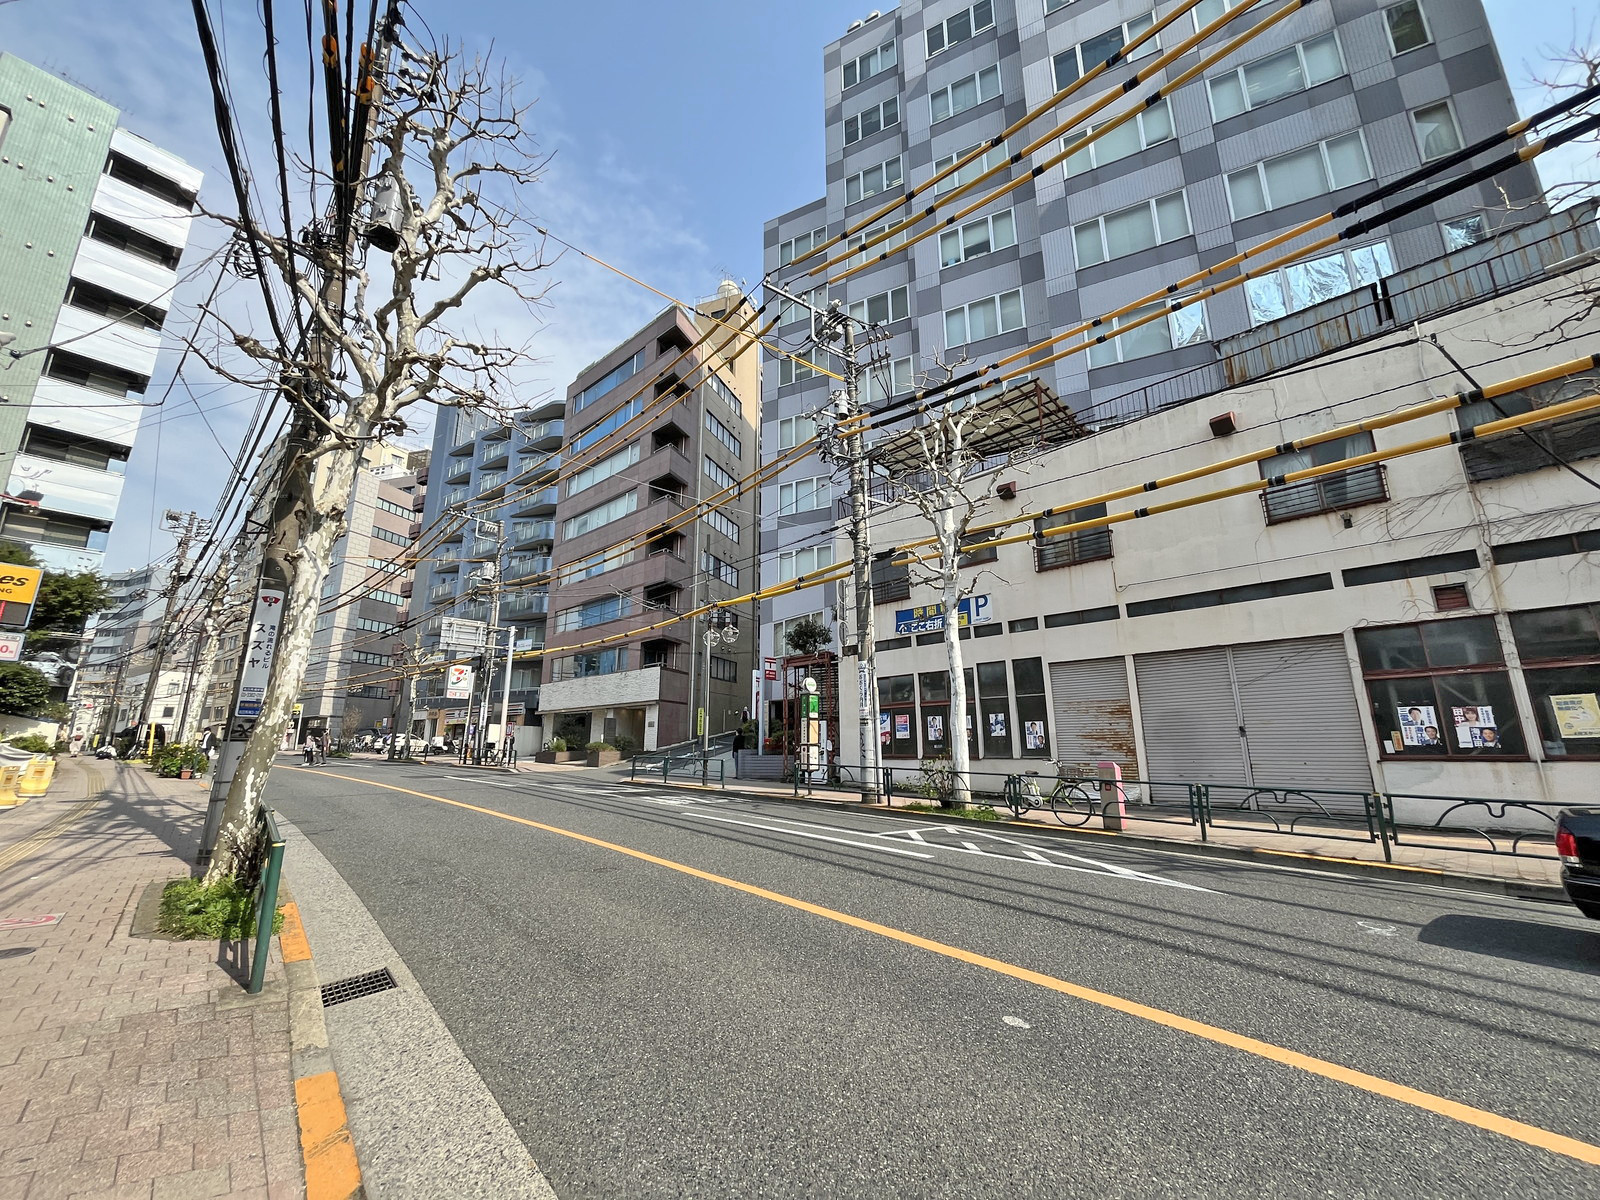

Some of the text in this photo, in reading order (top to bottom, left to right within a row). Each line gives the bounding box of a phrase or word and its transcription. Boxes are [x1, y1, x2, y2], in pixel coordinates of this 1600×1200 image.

[976, 595, 988, 616] P
[249, 623, 266, 668] スズヤ
